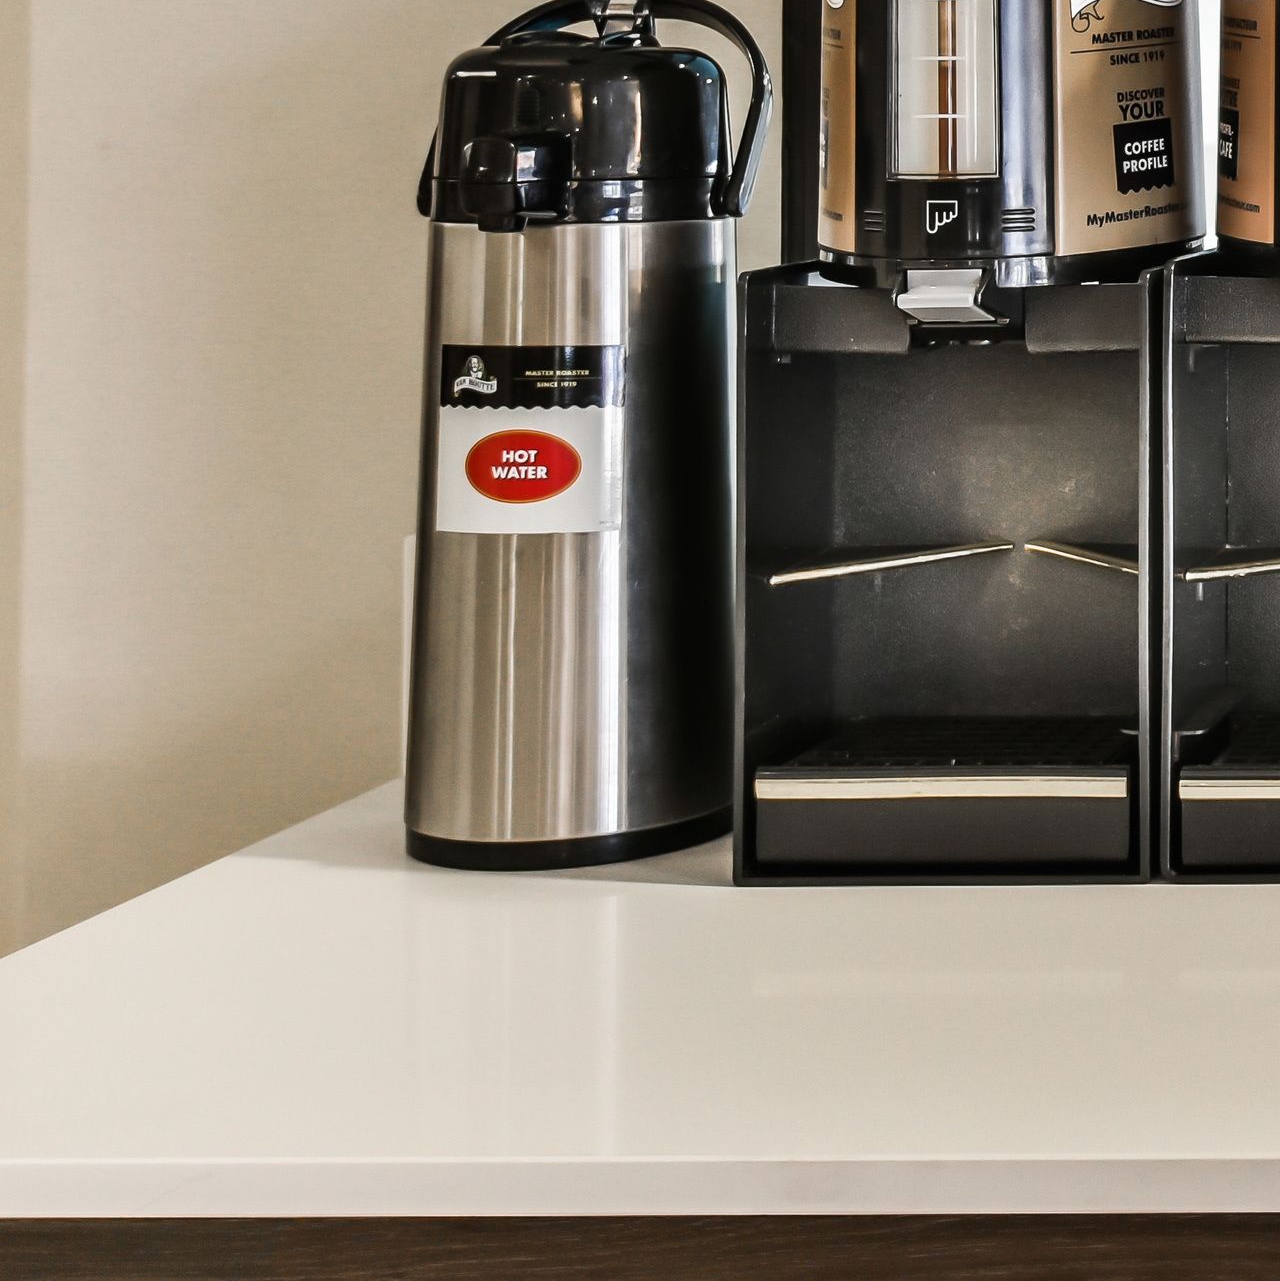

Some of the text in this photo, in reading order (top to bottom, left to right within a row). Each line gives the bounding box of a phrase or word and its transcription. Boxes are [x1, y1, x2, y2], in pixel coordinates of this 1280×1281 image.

[1092, 27, 1175, 44] MASTER ROASTER
[1110, 51, 1165, 65] SINCE 1919
[1117, 87, 1165, 103] DISCOVER
[1119, 101, 1164, 121] YOUR
[1125, 138, 1165, 155] COFFEE
[1123, 156, 1168, 173] PROFILE
[502, 450, 538, 463] HOT
[492, 466, 548, 479] WATER
